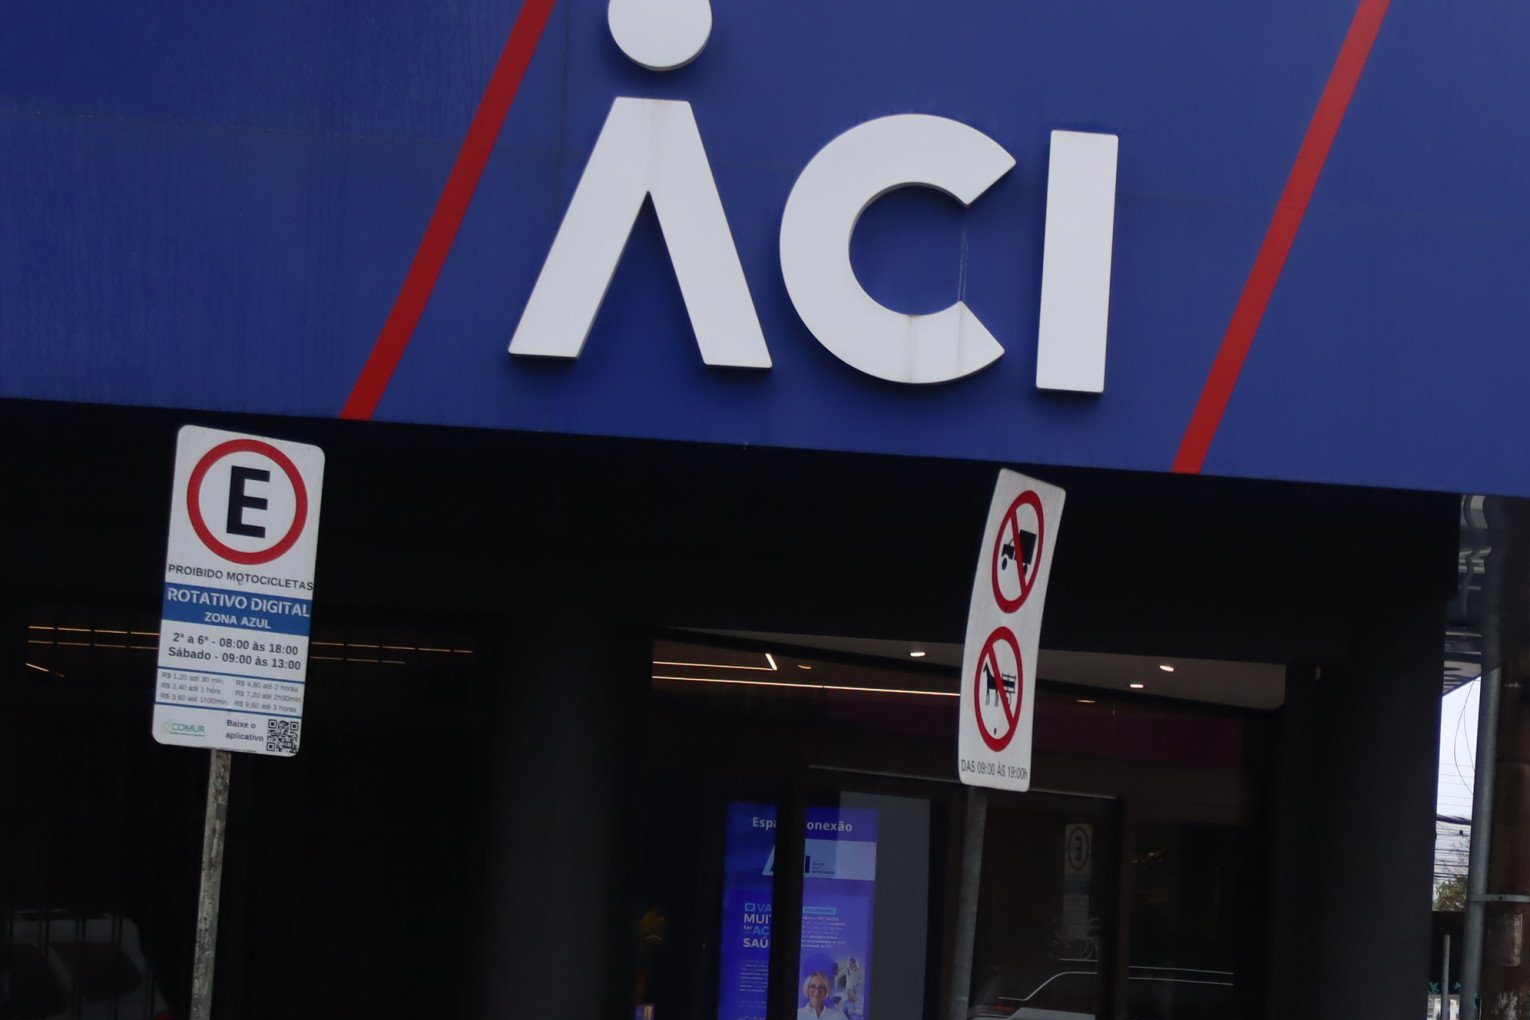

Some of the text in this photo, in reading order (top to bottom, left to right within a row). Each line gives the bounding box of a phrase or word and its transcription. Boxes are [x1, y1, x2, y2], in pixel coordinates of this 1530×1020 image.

[508, 97, 1119, 394] ACI
[226, 465, 271, 538] E
[168, 564, 314, 592] PROIBIDO MOTOCICLETAS
[167, 587, 310, 618] ROTATIVO DIGITAL
[204, 611, 272, 630] ZONA AZUL
[187, 635, 195, 645] a
[219, 637, 250, 650] 08:00
[252, 641, 266, 652] às
[268, 643, 299, 656] 18:00
[168, 646, 212, 661] Sábado
[221, 652, 252, 665] 09:00
[254, 655, 268, 667] às
[271, 658, 301, 671] 13:00
[161, 671, 171, 679] R$
[201, 675, 210, 683] 30
[160, 681, 170, 689] R$
[206, 687, 221, 695] hora
[235, 689, 244, 697] R$
[236, 679, 245, 687] R$
[280, 684, 299, 693] horas
[160, 692, 170, 700] R$
[234, 700, 243, 708] R$
[278, 705, 297, 713] horas
[171, 722, 206, 734] COMUR
[226, 719, 249, 729] Baixe
[225, 732, 264, 742] aplicativo
[961, 759, 975, 773] DAS
[977, 761, 996, 775] 09:00
[997, 761, 1005, 777] ÀS
[806, 820, 853, 832] onexão
[752, 926, 771, 936] AC
